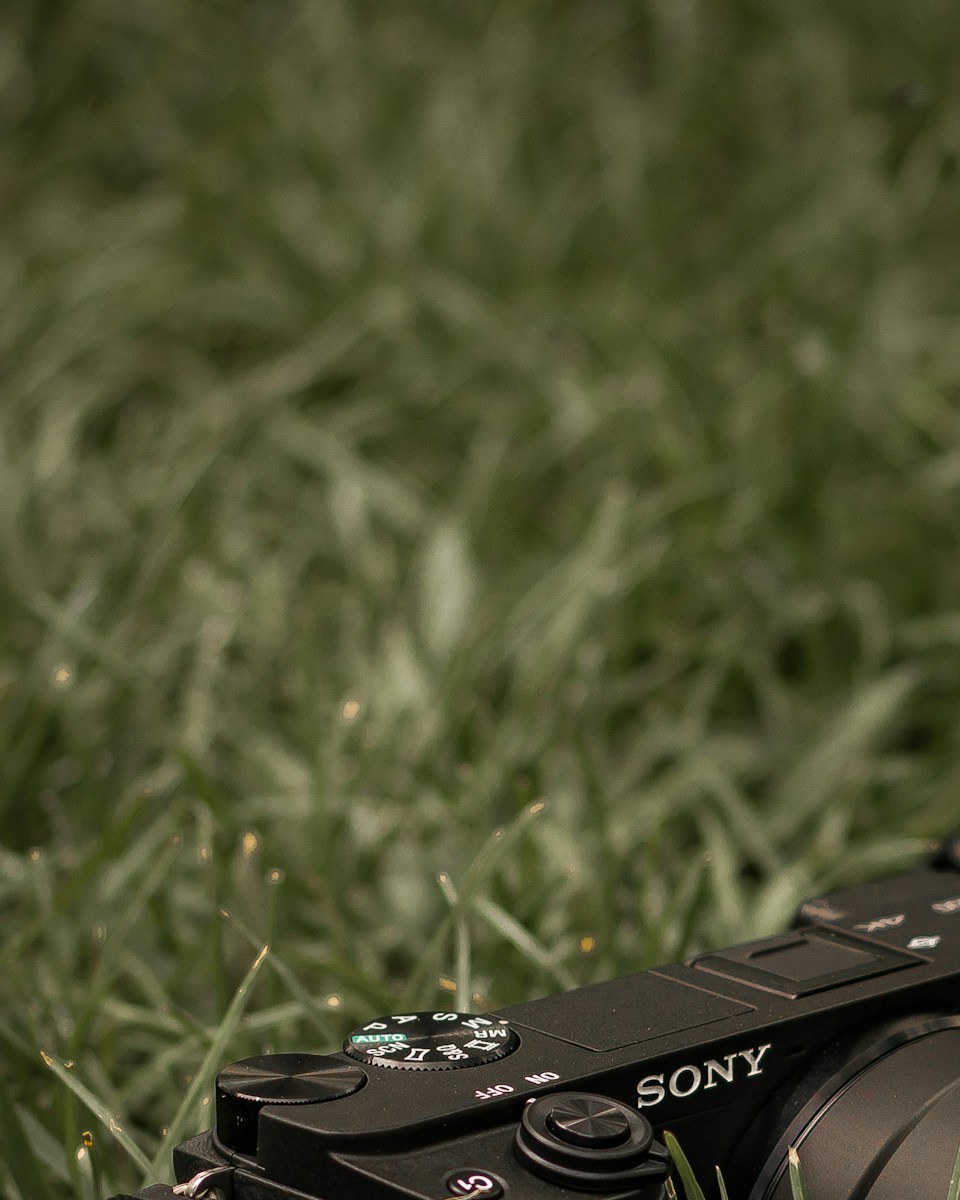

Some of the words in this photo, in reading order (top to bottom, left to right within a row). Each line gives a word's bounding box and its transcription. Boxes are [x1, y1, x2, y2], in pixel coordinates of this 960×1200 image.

[391, 1015, 417, 1024] A
[432, 1012, 459, 1021] S
[363, 1022, 387, 1032] P
[461, 1017, 493, 1029] M
[356, 1034, 404, 1043] AUTO
[474, 1030, 507, 1039] MR
[366, 1041, 411, 1057] SCN
[525, 1071, 560, 1085] ON
[636, 1043, 772, 1109] SONY
[475, 1084, 515, 1100] OFF
[457, 1175, 493, 1191] C1
